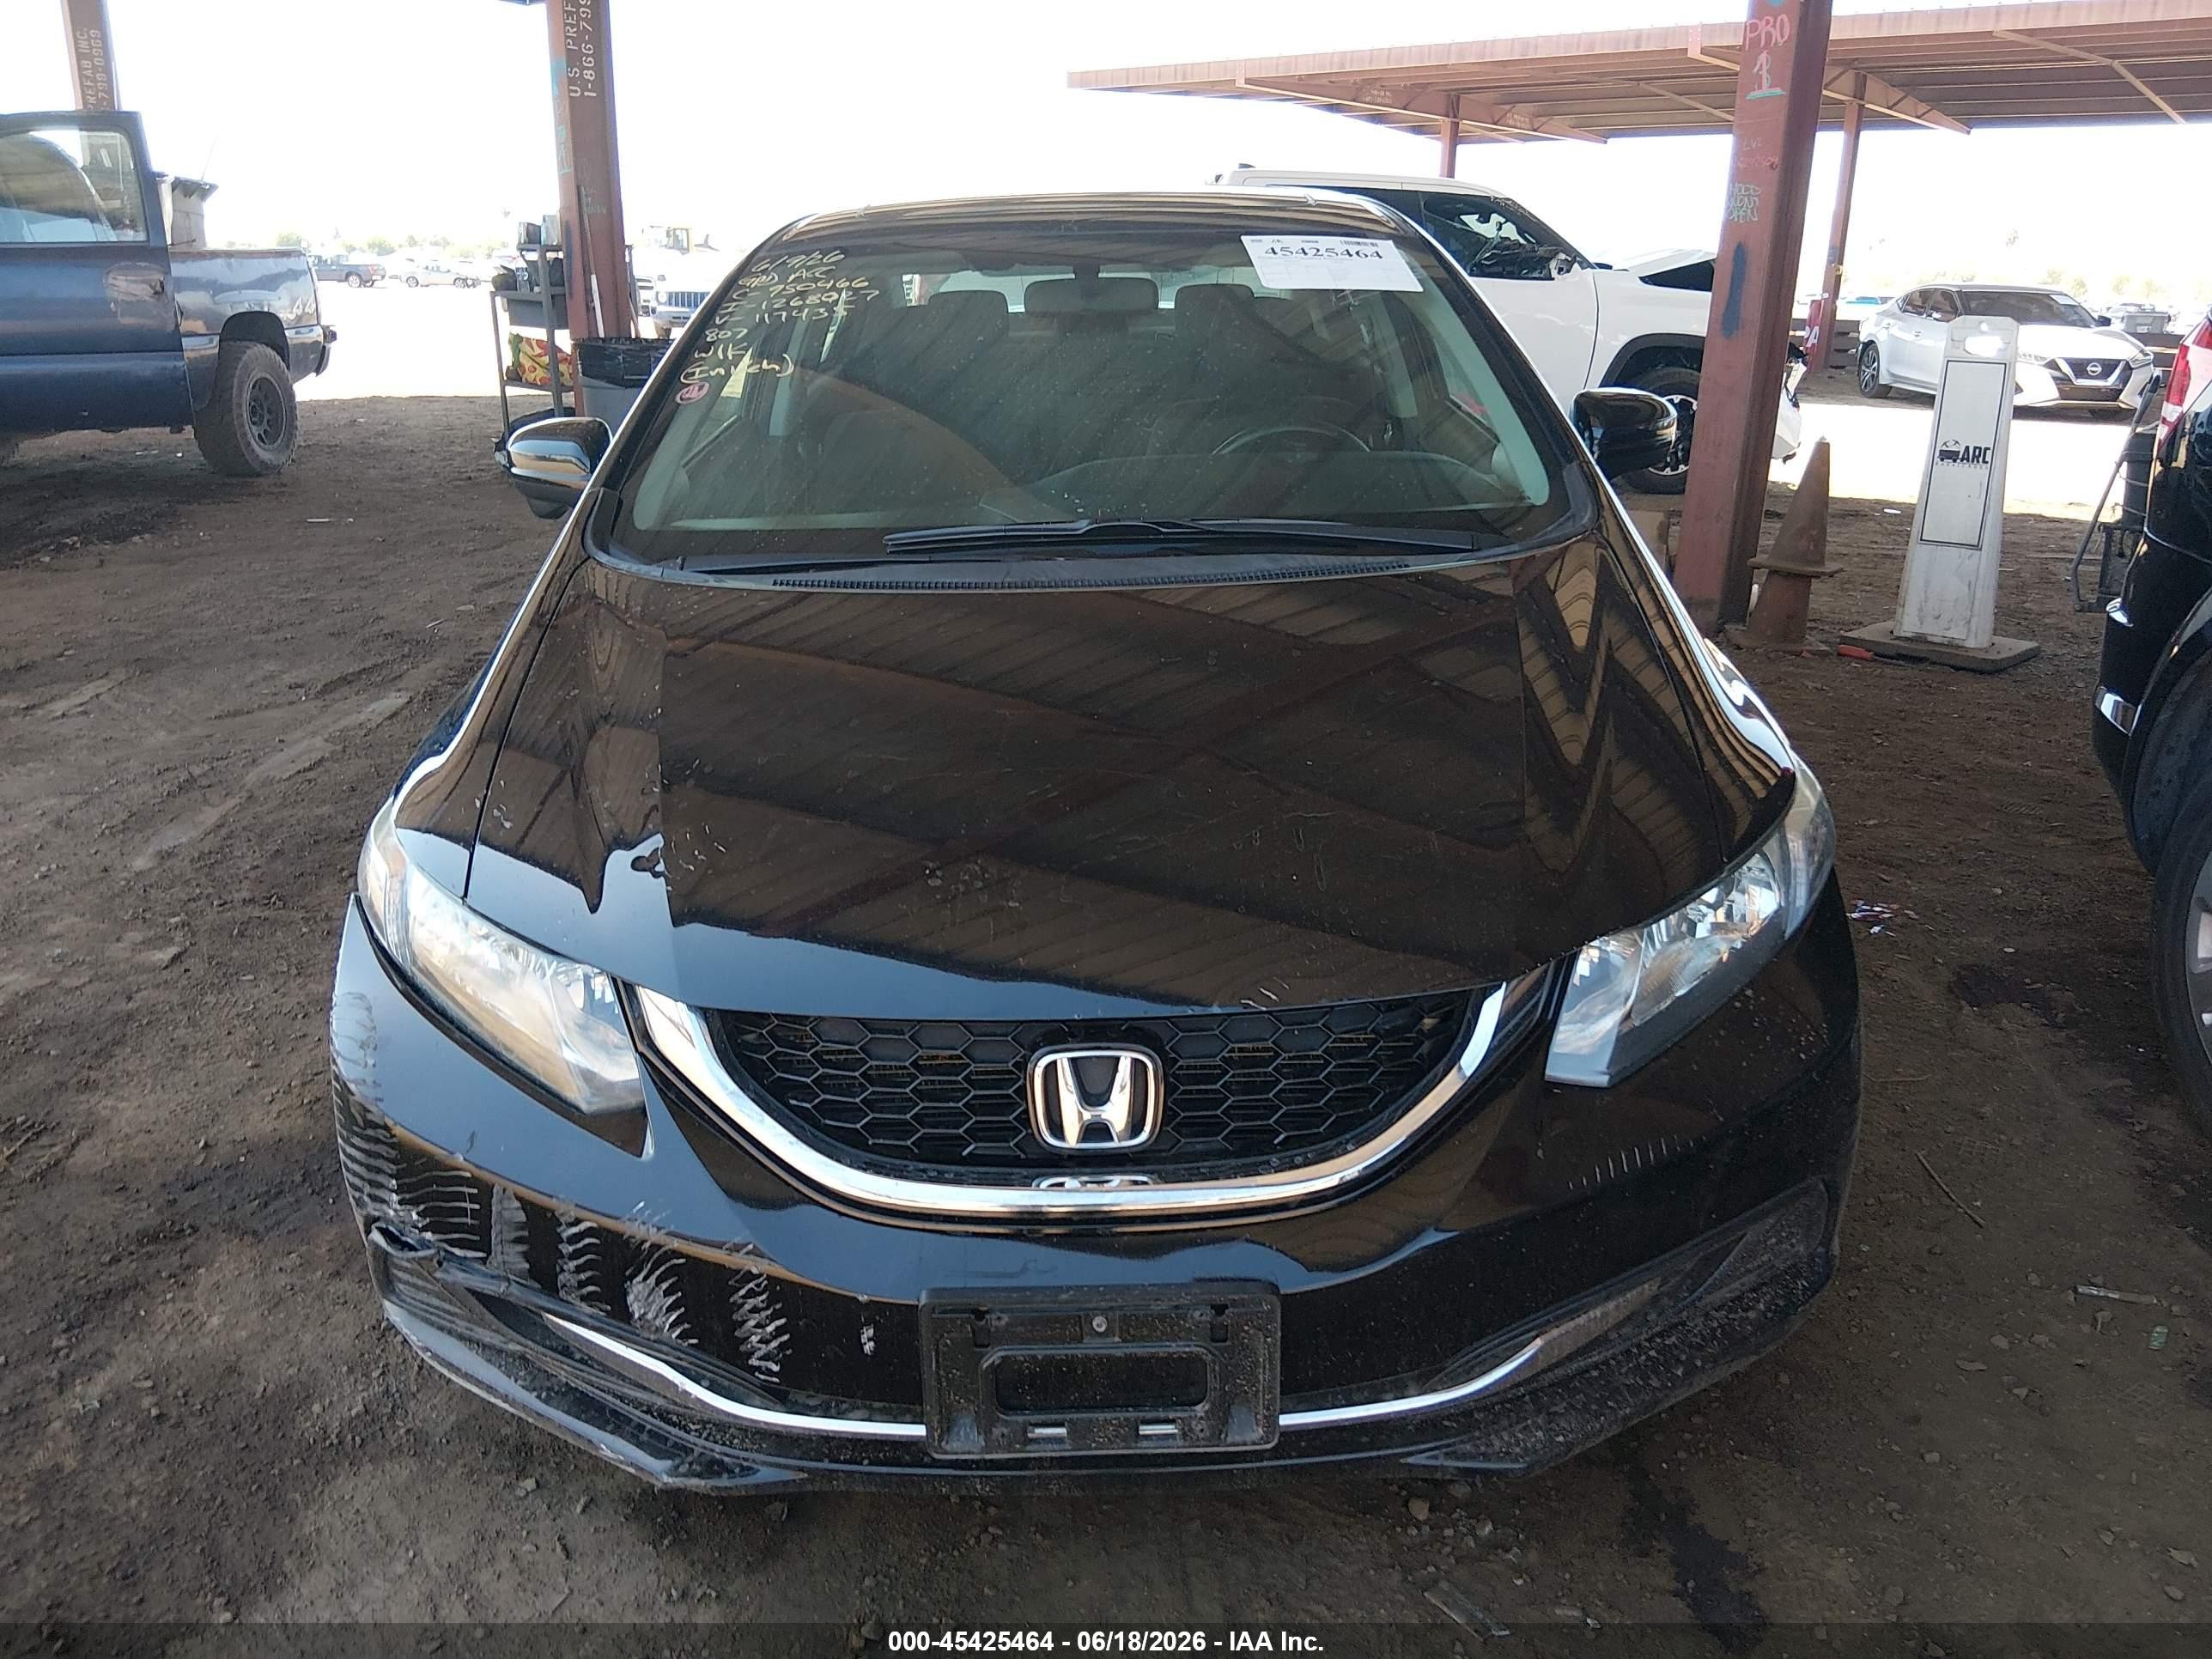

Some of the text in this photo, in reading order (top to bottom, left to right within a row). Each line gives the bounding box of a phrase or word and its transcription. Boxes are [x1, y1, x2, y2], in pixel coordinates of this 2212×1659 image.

[76, 27, 90, 53] INC.
[1745, 14, 1790, 51] PRO
[88, 29, 110, 110] -799-0969
[568, 62, 581, 97] U.S.
[1265, 246, 1383, 260] 45425464
[704, 328, 749, 343] 807
[1960, 445, 1991, 465] ARC
